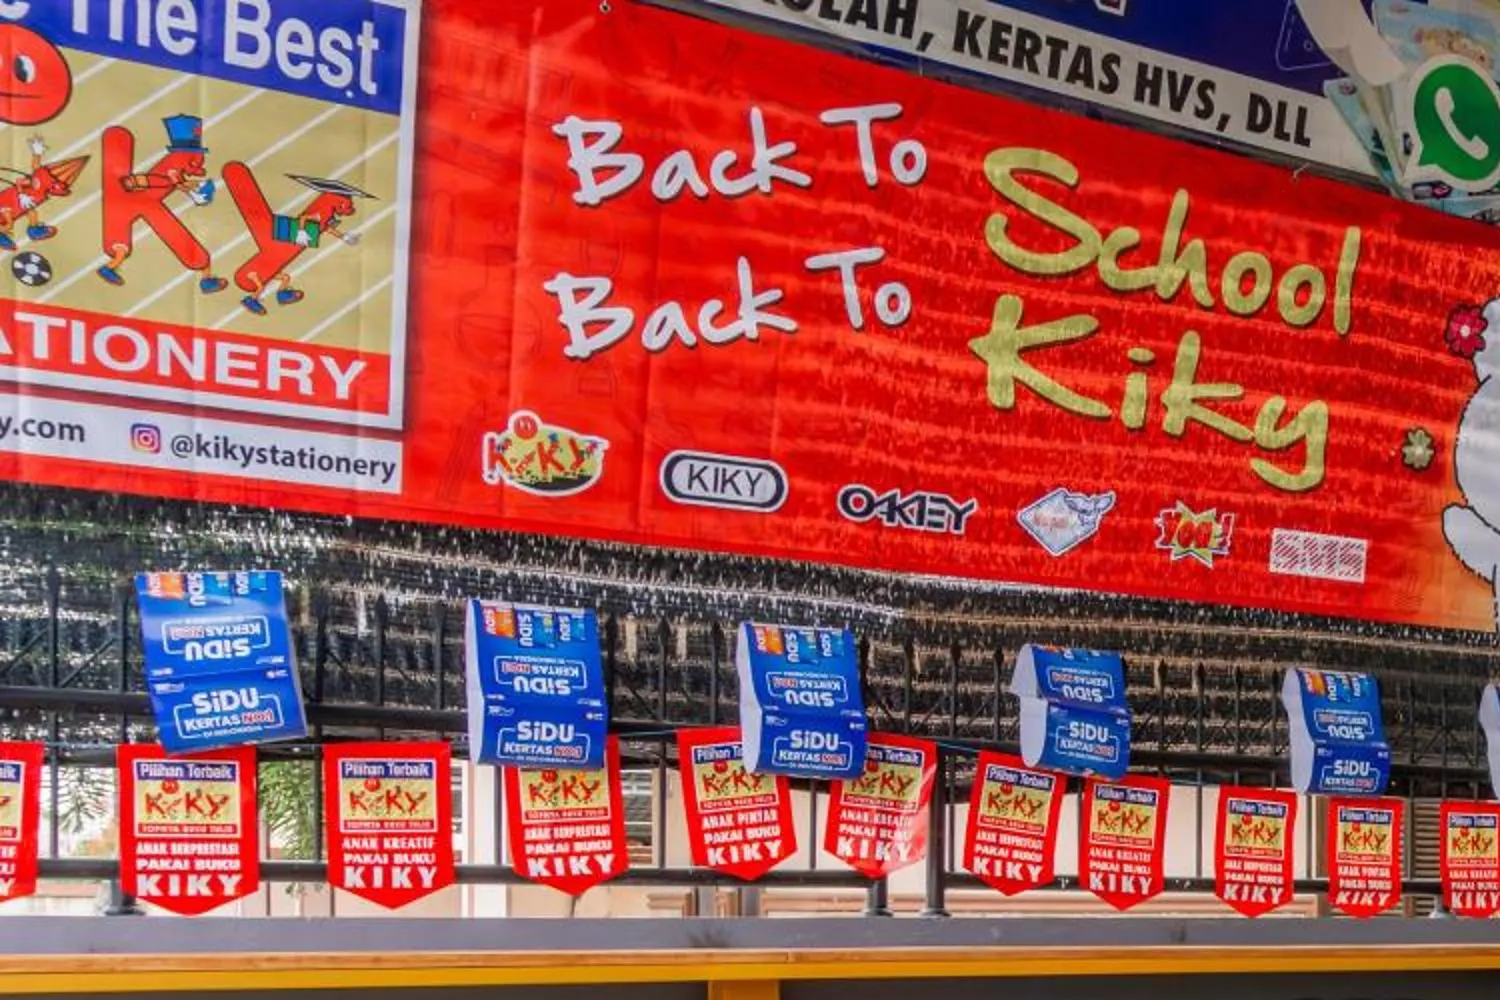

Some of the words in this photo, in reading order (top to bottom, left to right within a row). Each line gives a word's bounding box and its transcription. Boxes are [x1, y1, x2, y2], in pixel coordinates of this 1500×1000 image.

[223, 0, 379, 97] Best
[952, 10, 1120, 94] KERTAS
[1134, 62, 1232, 131] HVS,
[1246, 90, 1313, 147] DLL
[552, 107, 812, 205] Back
[820, 102, 927, 187] To
[984, 146, 1361, 336] School
[544, 256, 798, 359] Back
[805, 247, 912, 330] To
[968, 294, 1329, 491] Kiky
[170, 433, 396, 482] @kikystationery
[687, 463, 763, 498] KIKY
[136, 859, 188, 870] PAKAI
[342, 852, 389, 863] PAKAI
[526, 853, 614, 876] KIKY
[704, 838, 784, 865] KIKY
[971, 855, 1042, 883] KIKY
[136, 874, 241, 896] KIKY
[342, 866, 436, 887] KIKY
